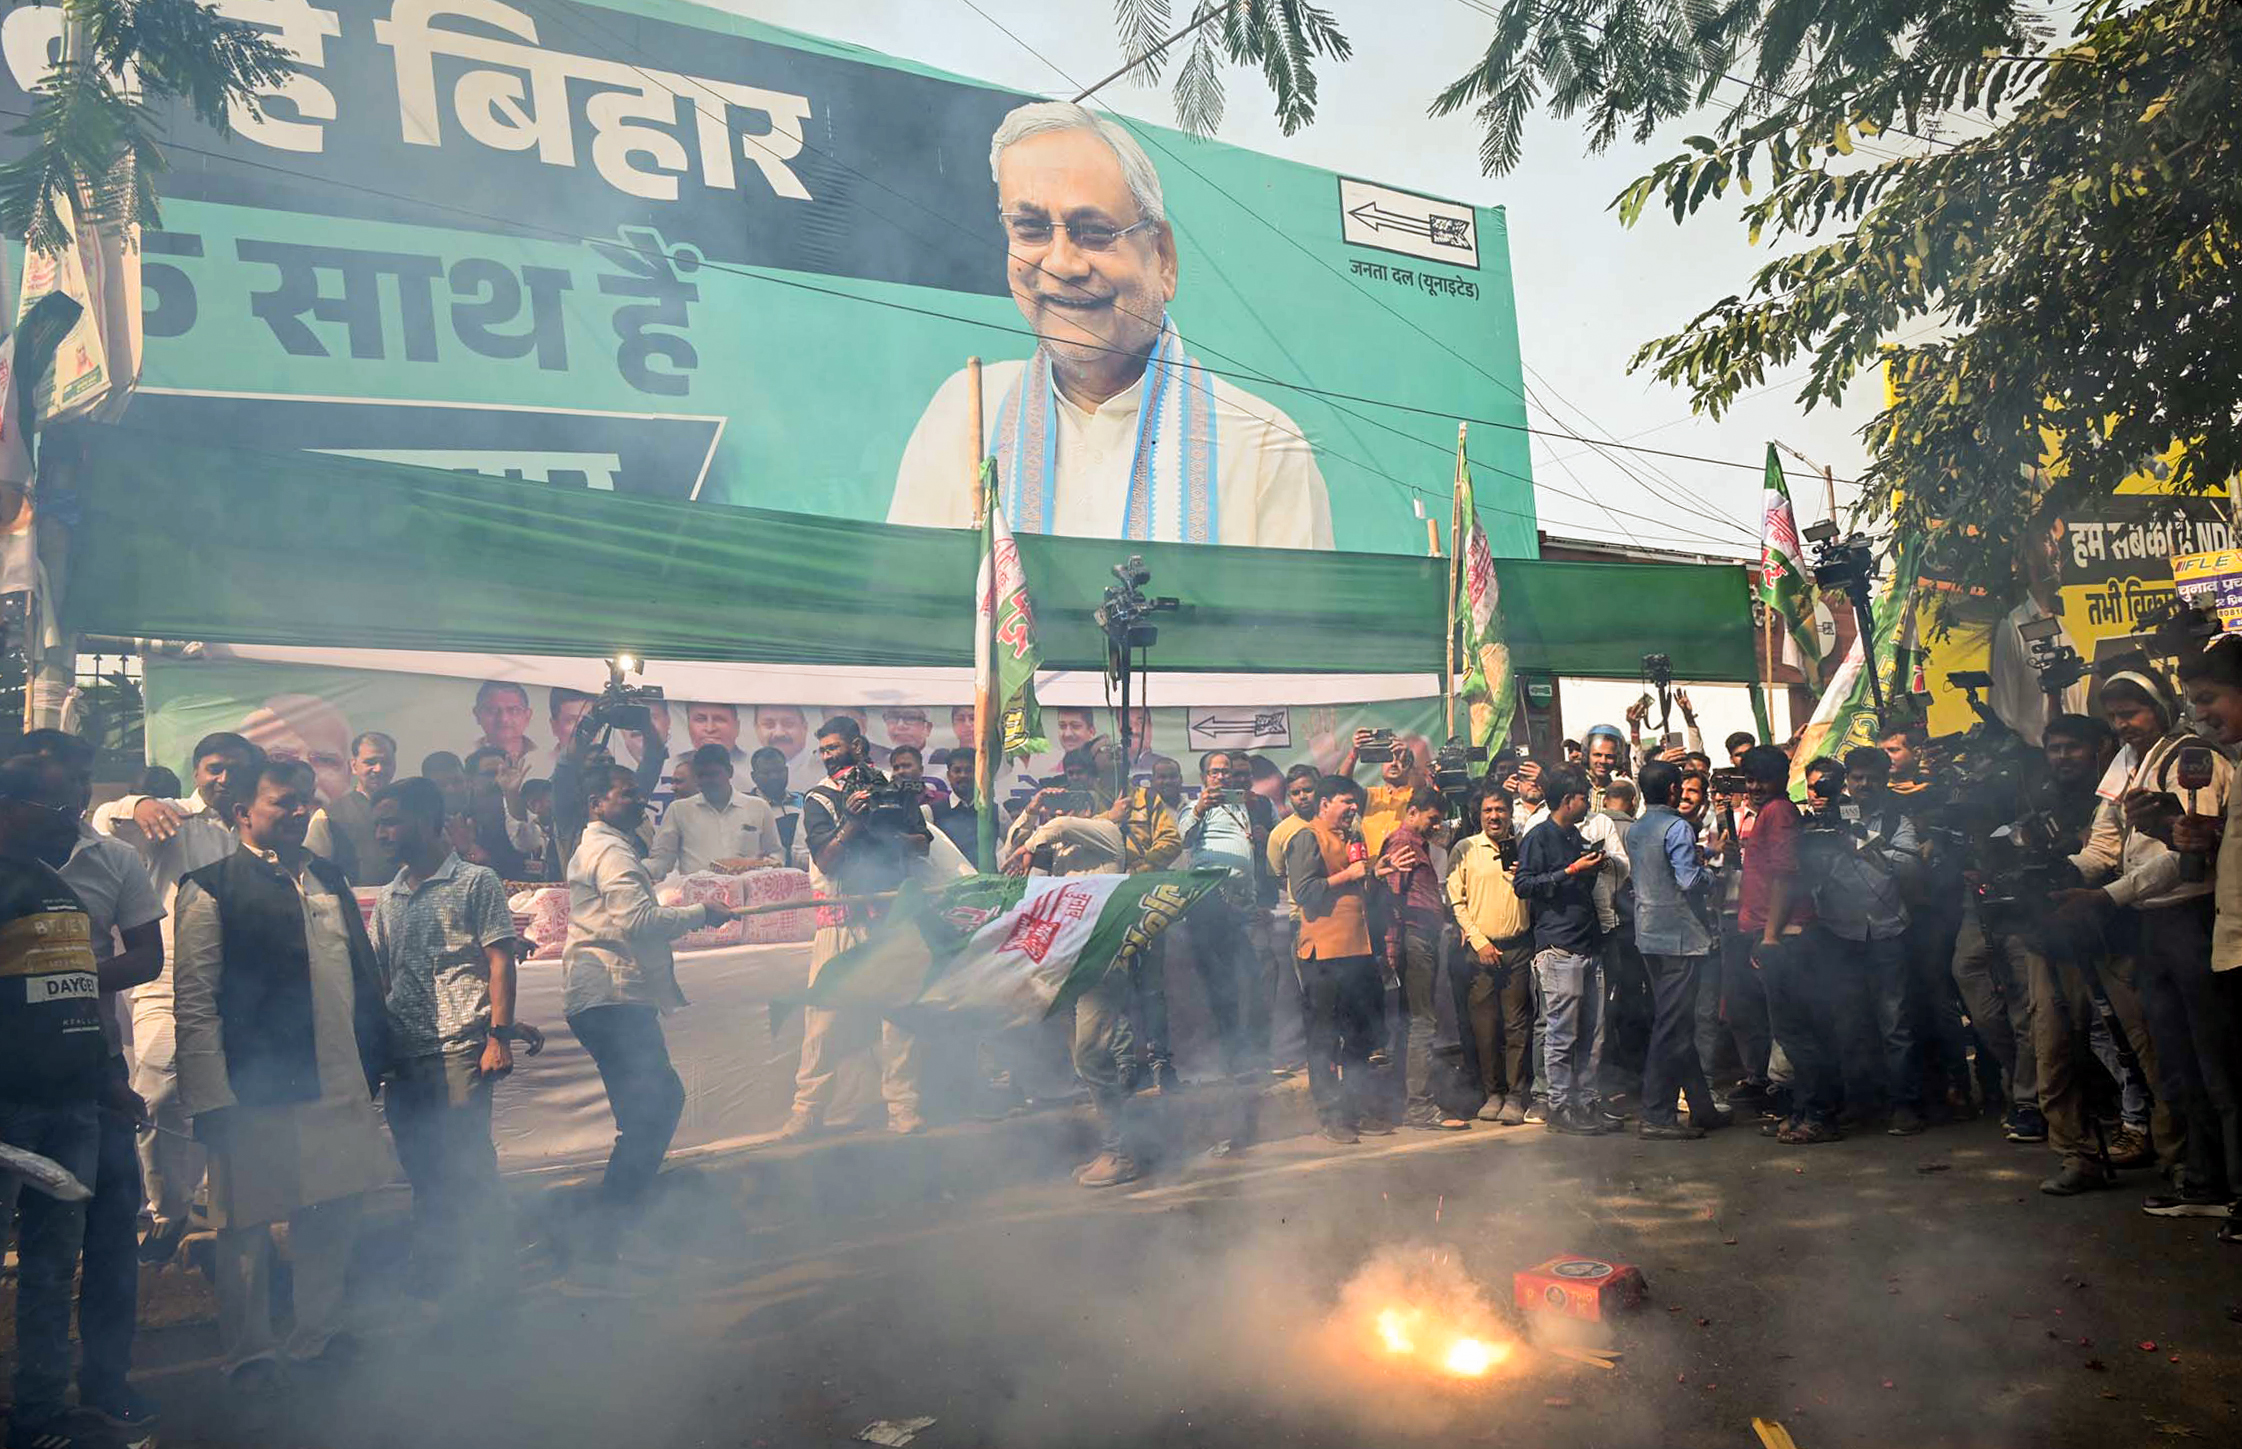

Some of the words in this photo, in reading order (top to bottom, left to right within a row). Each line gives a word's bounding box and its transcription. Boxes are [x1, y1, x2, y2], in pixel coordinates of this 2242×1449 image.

[373, 0, 813, 200] बिहार
[1349, 259, 1388, 281] जनता
[1391, 267, 1414, 287] दल
[1418, 272, 1480, 301] (यूनाइटेड)
[235, 237, 574, 373] साथ
[588, 224, 706, 397] हैं
[2068, 522, 2106, 568] हम
[2086, 577, 2123, 625] तभी
[2177, 581, 2219, 603] चुनाव
